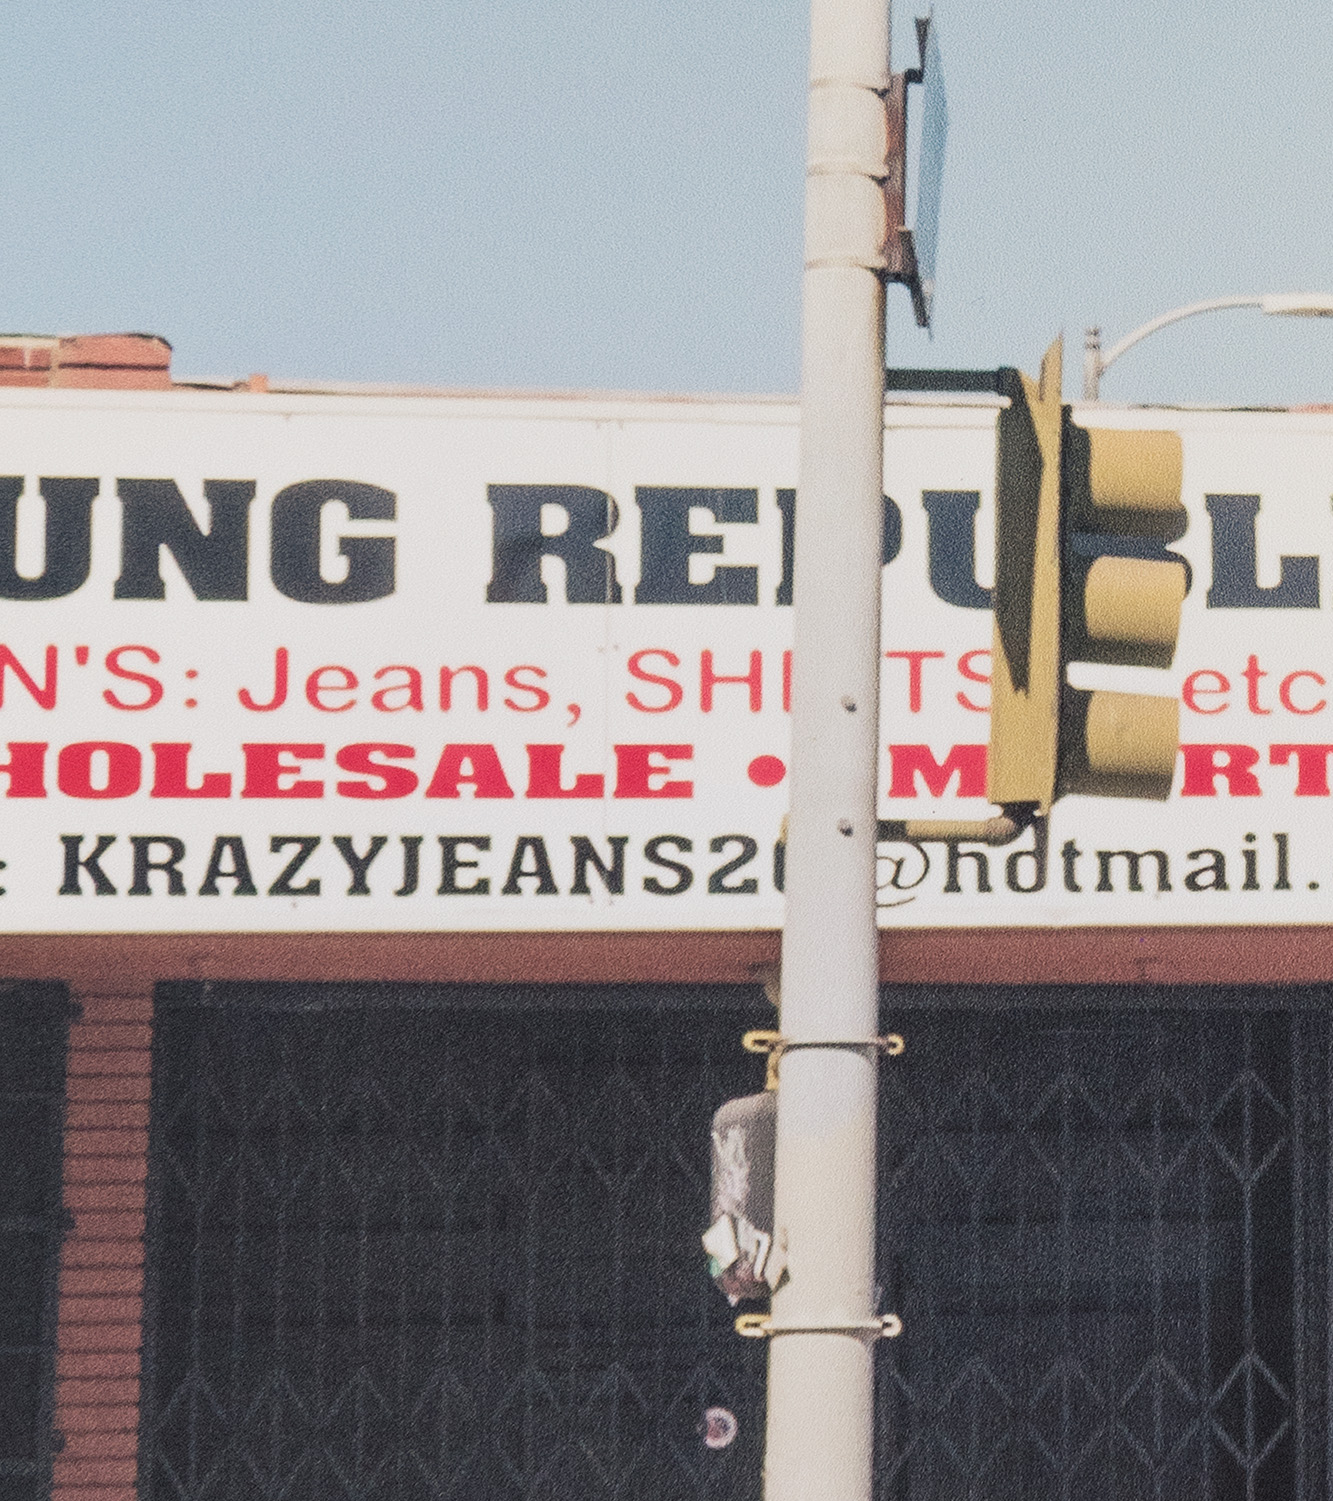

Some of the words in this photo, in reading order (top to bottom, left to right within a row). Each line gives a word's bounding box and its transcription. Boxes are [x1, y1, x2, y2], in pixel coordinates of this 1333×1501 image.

[0, 475, 397, 604] UNG
[237, 645, 583, 728] Jeans,
[625, 648, 990, 714] SHITS
